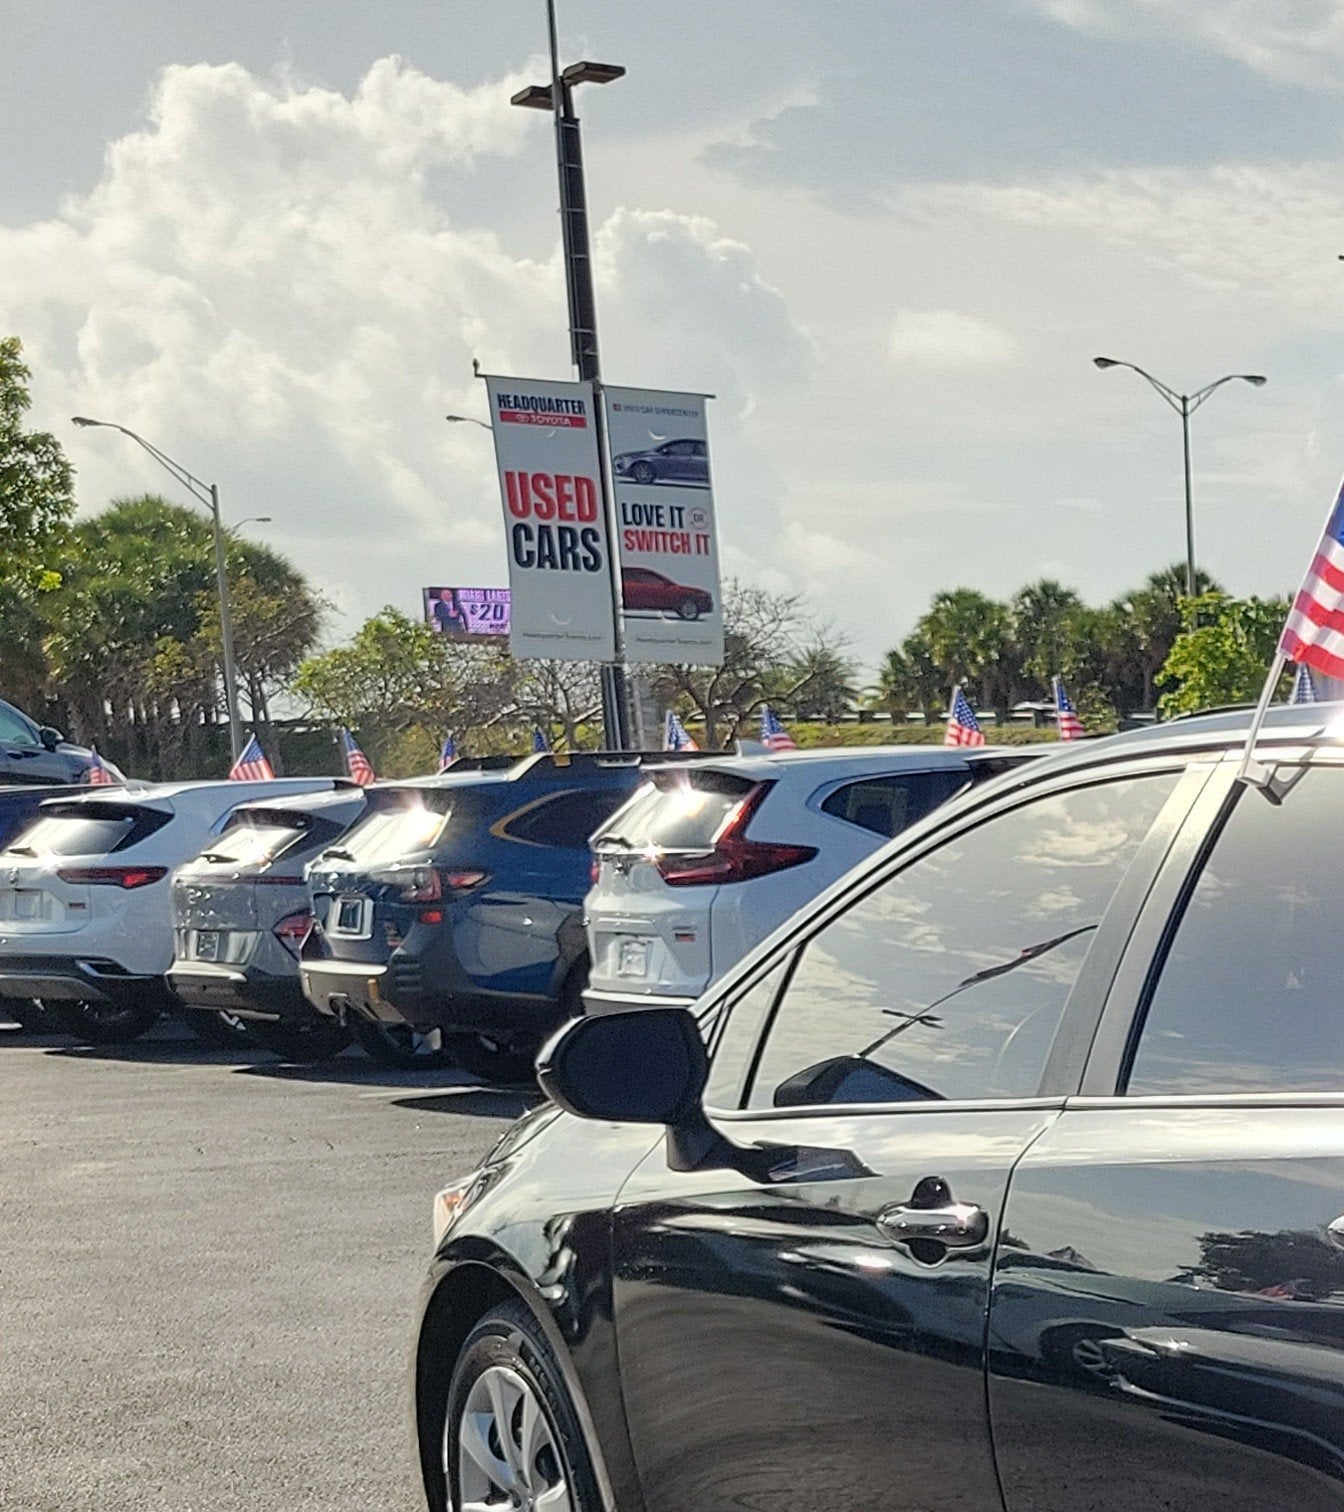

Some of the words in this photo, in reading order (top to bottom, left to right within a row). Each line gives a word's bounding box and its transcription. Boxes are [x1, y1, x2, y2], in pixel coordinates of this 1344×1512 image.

[497, 393, 586, 415] HEADQUARTER
[529, 414, 572, 427] TOYOTA
[504, 470, 598, 523] USED
[622, 502, 665, 528] LOVE
[669, 505, 685, 528] IT
[512, 522, 602, 572] CARS
[624, 529, 691, 555] SWITCH
[696, 533, 710, 556] IT
